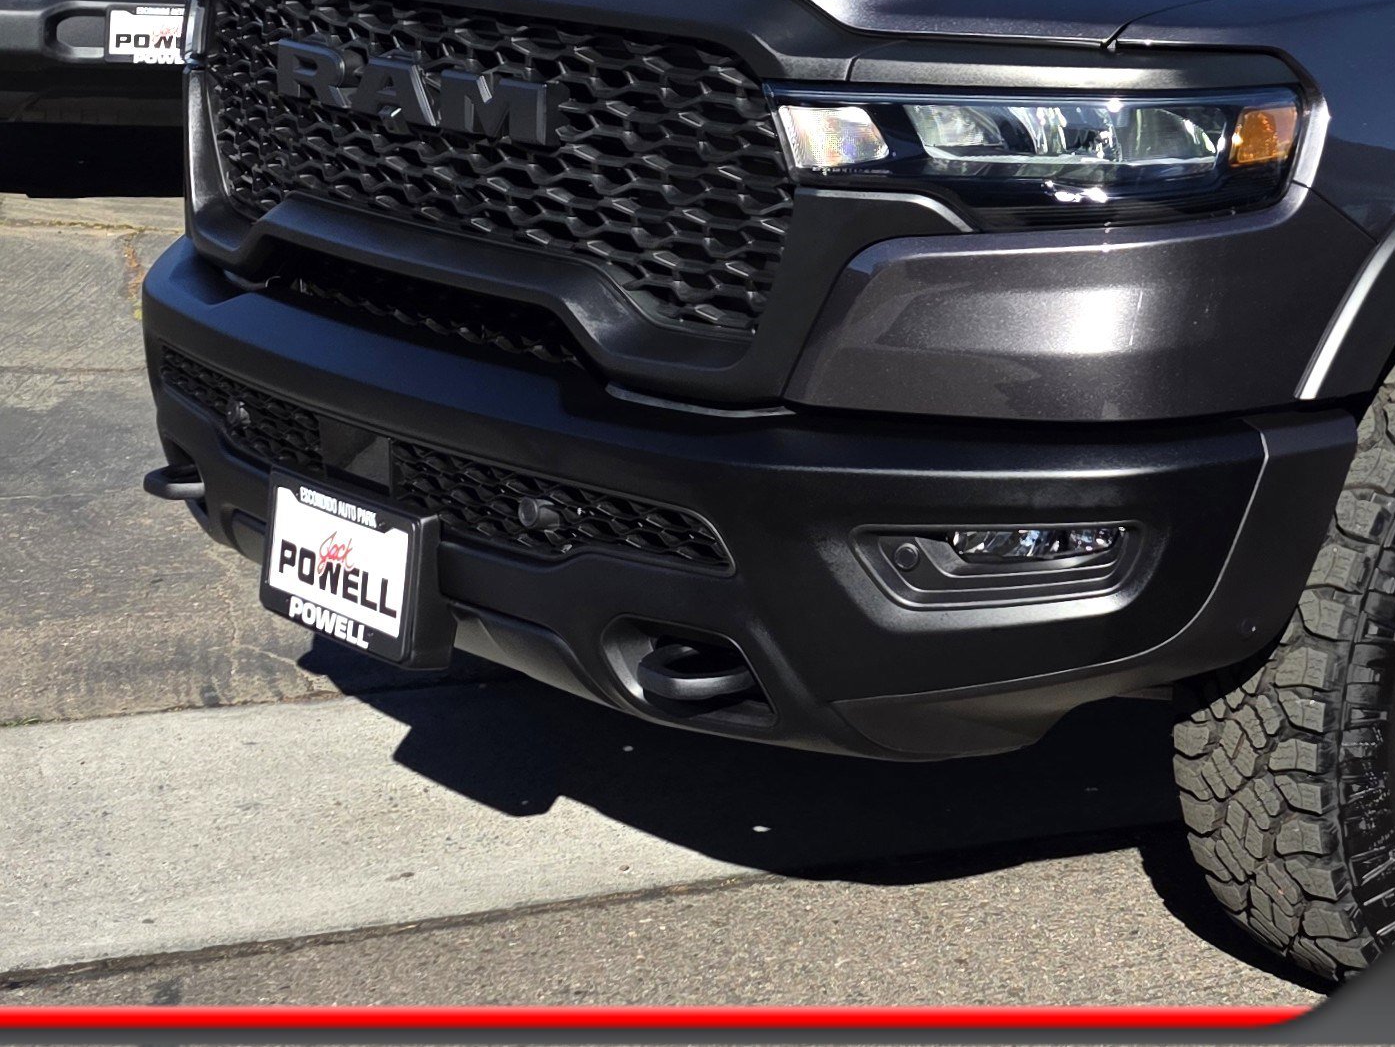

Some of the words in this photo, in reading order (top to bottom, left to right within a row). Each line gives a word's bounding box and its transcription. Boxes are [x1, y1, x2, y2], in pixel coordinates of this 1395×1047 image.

[277, 38, 548, 145] RAM
[279, 539, 397, 618] POWELL
[317, 531, 354, 575] Jack
[288, 595, 369, 649] POWELL
